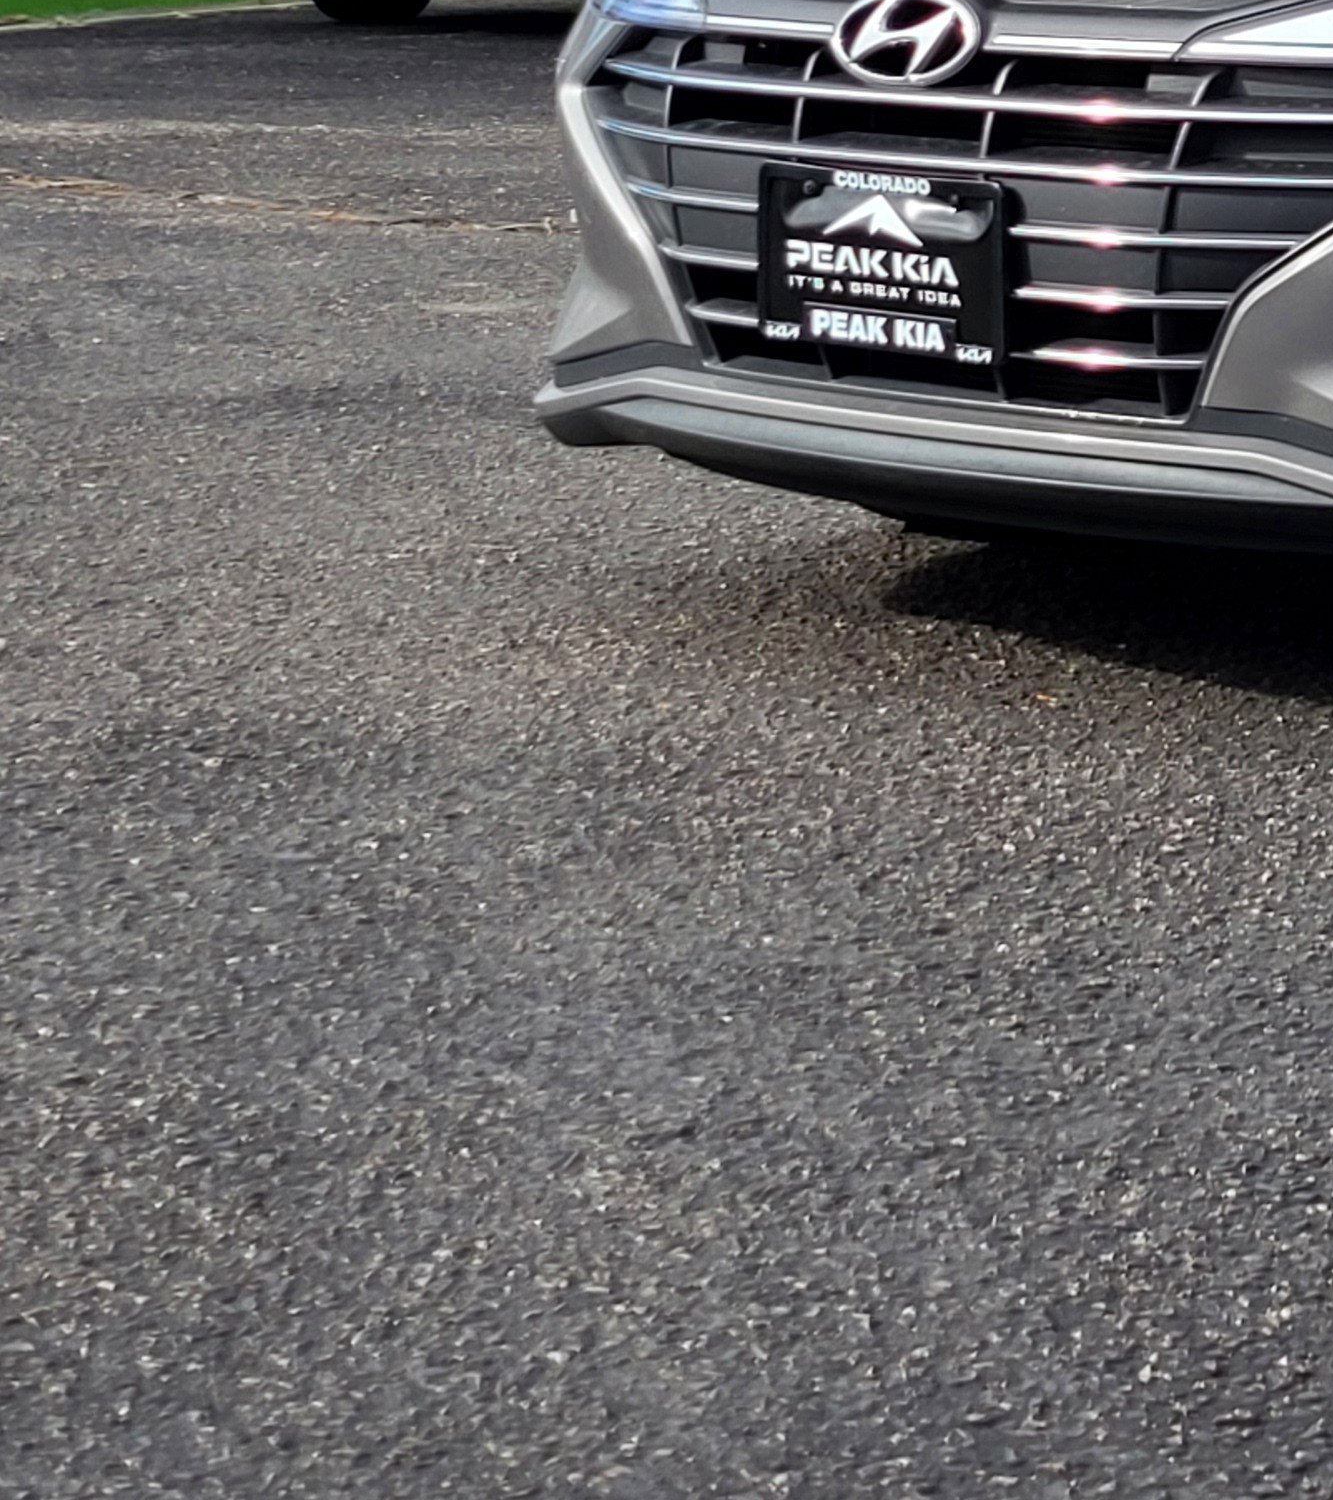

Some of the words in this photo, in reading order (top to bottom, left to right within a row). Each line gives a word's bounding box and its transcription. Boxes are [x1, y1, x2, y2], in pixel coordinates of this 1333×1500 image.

[832, 170, 931, 196] COLORADO
[785, 238, 889, 278] PEAK
[788, 274, 825, 291] IT'S
[830, 278, 844, 292] A
[849, 281, 911, 300] GREAT
[917, 289, 962, 308] IDEA
[810, 308, 889, 344] PEAK
[894, 318, 946, 352] KIA
